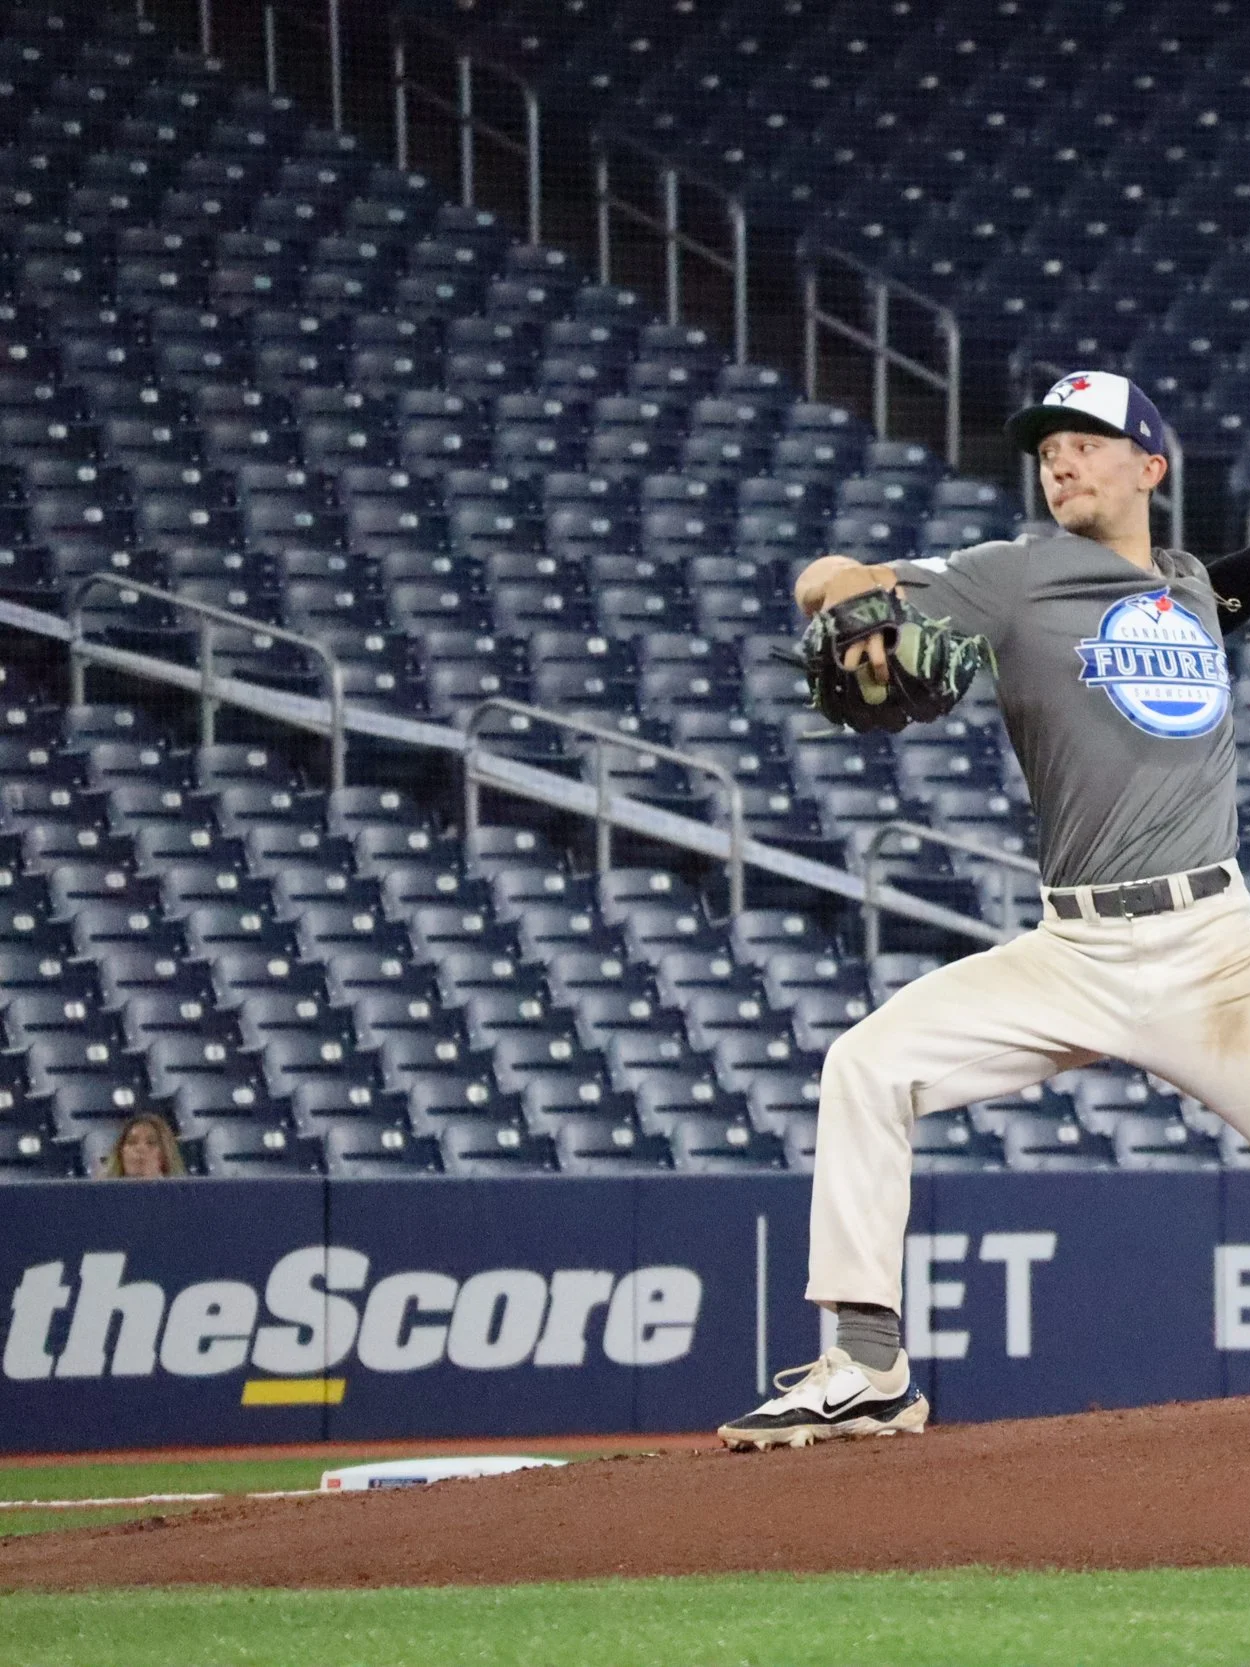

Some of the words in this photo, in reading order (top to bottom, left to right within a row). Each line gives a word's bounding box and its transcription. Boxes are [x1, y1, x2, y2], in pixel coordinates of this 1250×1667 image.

[1121, 627, 1198, 641] CANADIAN
[1094, 647, 1228, 682] FUTURES
[3, 1246, 702, 1379] theScore
[820, 1231, 1058, 1359] ET
